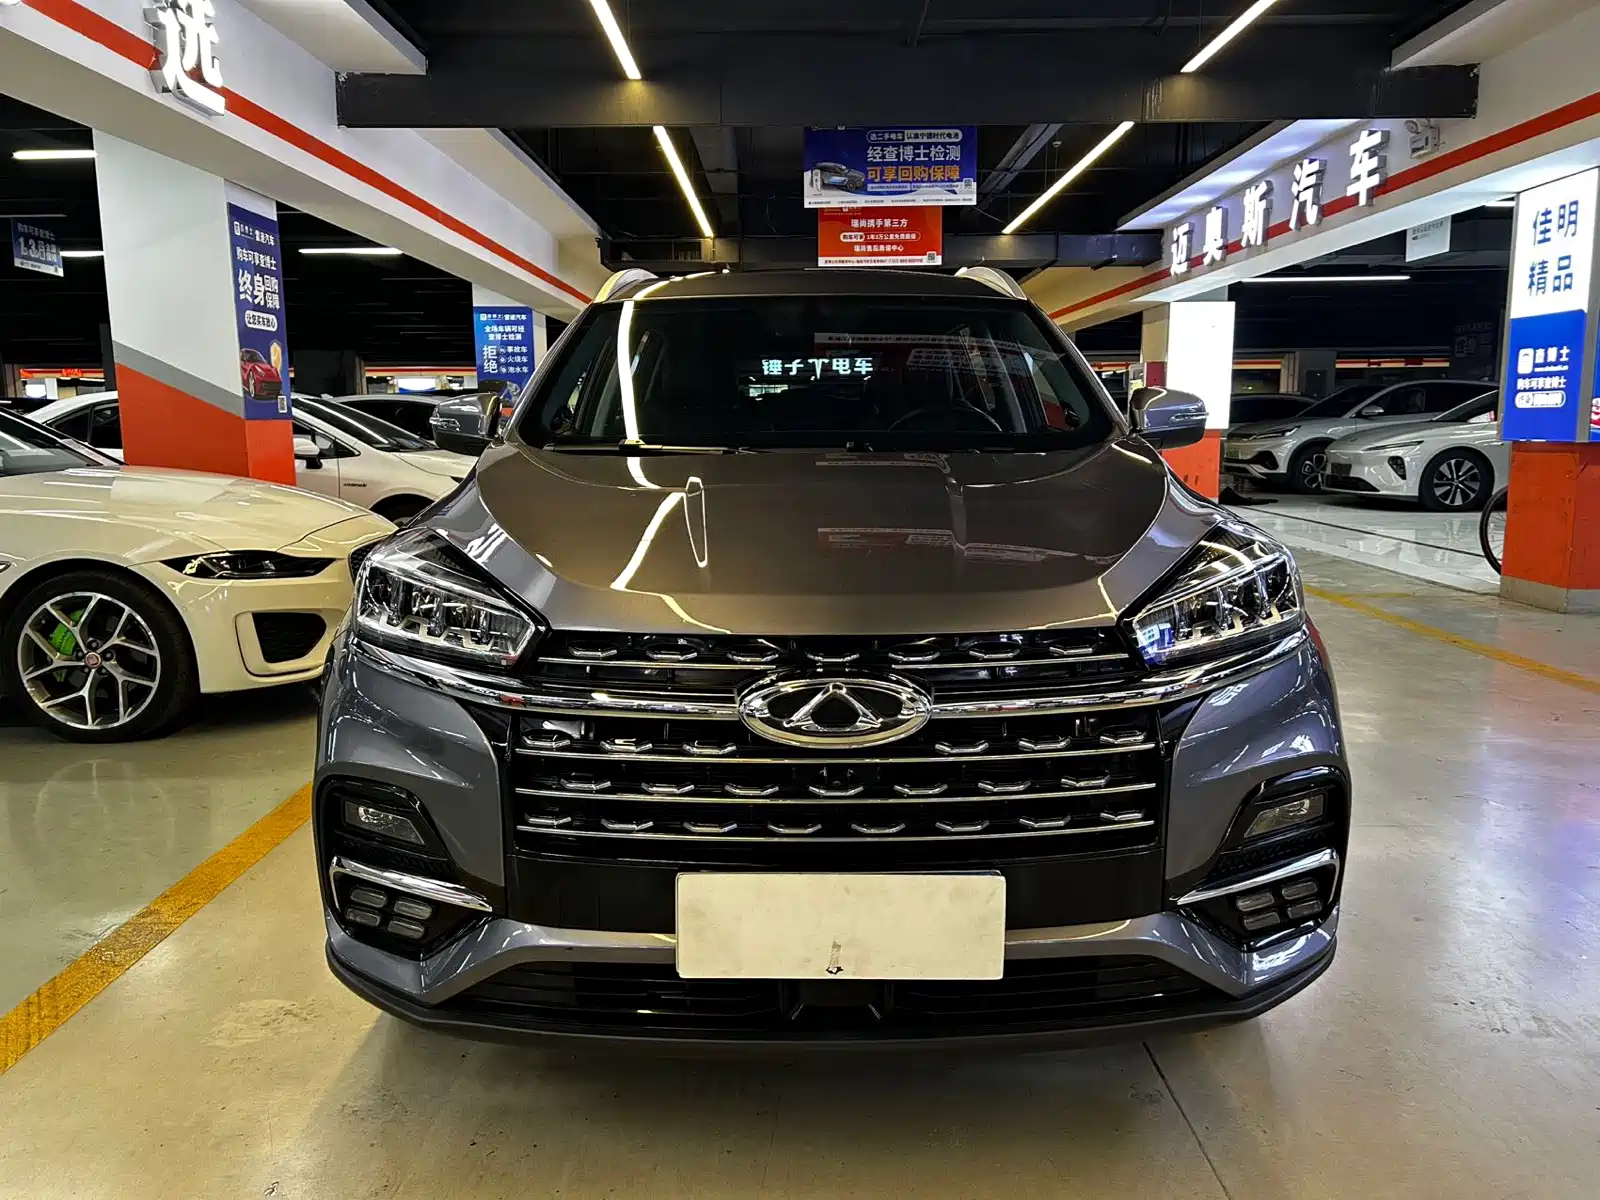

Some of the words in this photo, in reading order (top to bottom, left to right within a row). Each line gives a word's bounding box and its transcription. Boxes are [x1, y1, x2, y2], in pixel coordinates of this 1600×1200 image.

[866, 144, 961, 162] 经查博士检测
[867, 164, 961, 182] 可享回购保障
[1170, 129, 1390, 276] 迈奥斯汽车
[850, 218, 909, 229] 瑞尚携手第三方
[1532, 199, 1579, 247] 佳明
[236, 246, 277, 270] 购车可享查博士
[1527, 254, 1574, 297] 精品
[238, 268, 265, 306] 终身
[263, 274, 279, 293] 回购
[266, 291, 280, 309] 保障
[484, 325, 525, 333] 全场车辆可经
[488, 333, 522, 341] 查博士检测
[482, 344, 498, 373] 拒绝
[1534, 346, 1570, 364] 查博士
